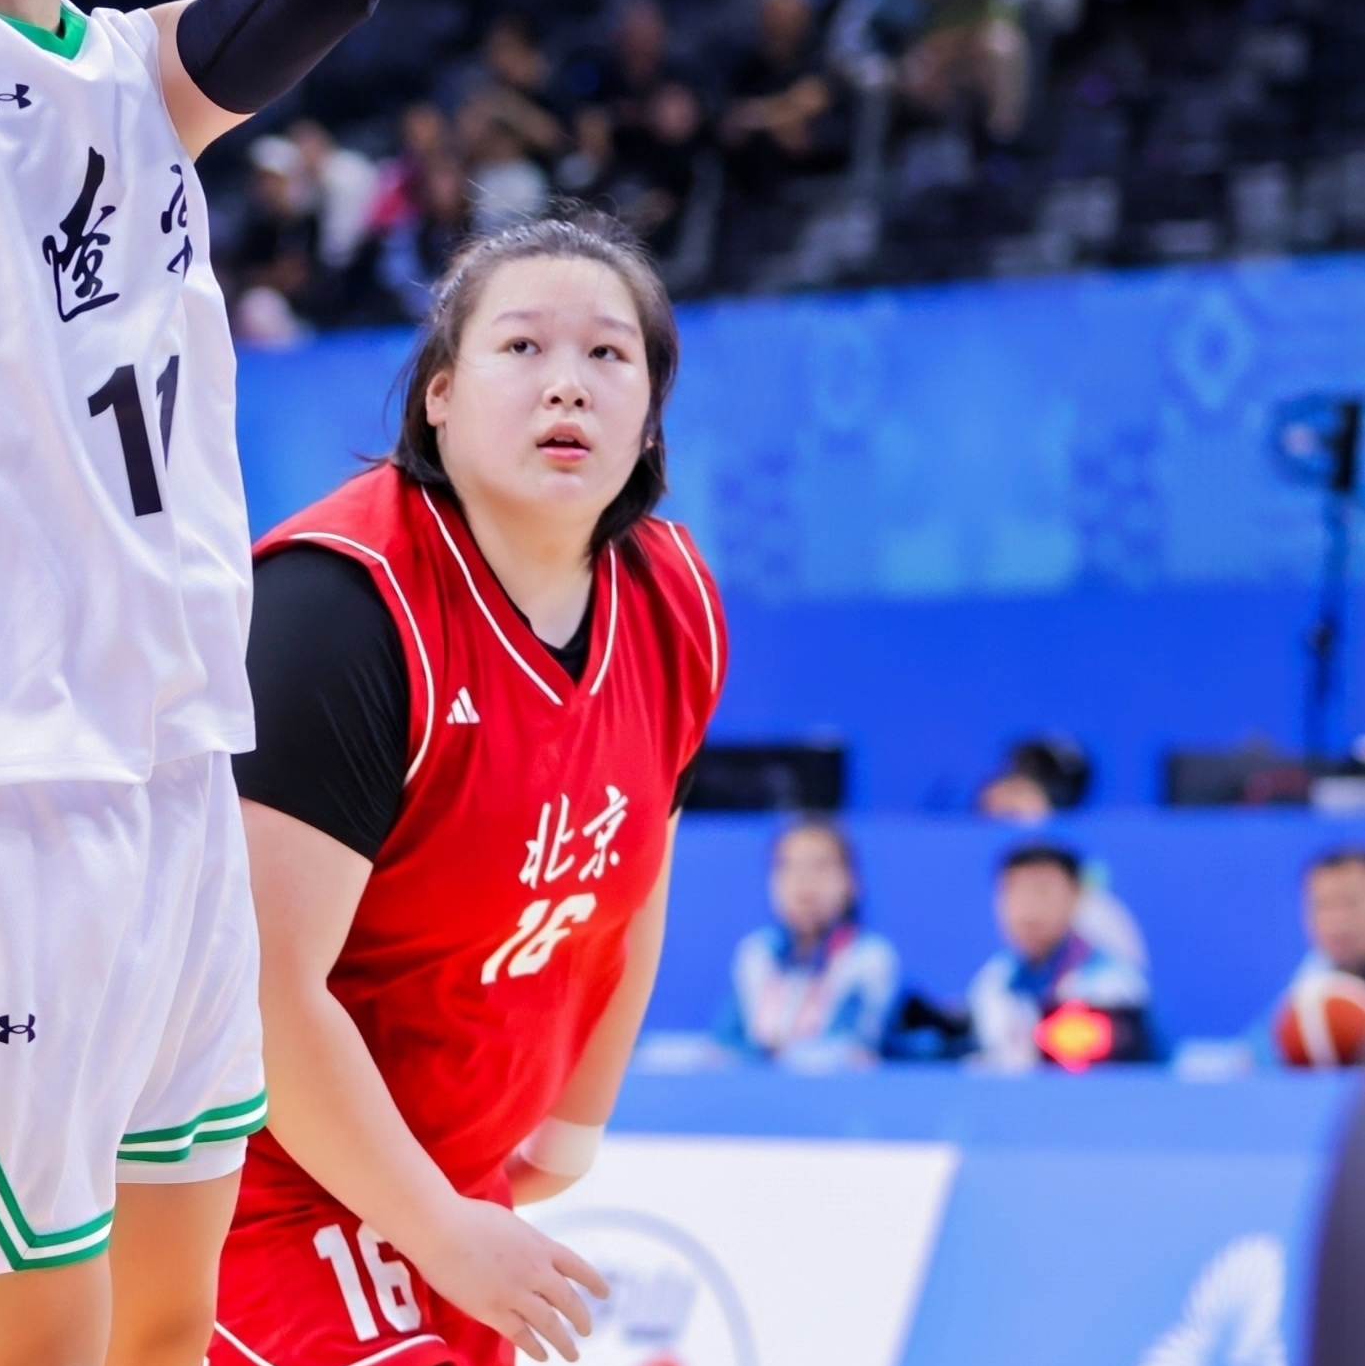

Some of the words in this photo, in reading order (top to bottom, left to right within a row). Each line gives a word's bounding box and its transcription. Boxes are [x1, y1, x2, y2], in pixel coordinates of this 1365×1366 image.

[88, 354, 181, 517] 11
[518, 785, 628, 889] 北京
[480, 893, 596, 985] 16
[313, 1223, 420, 1341] 16
